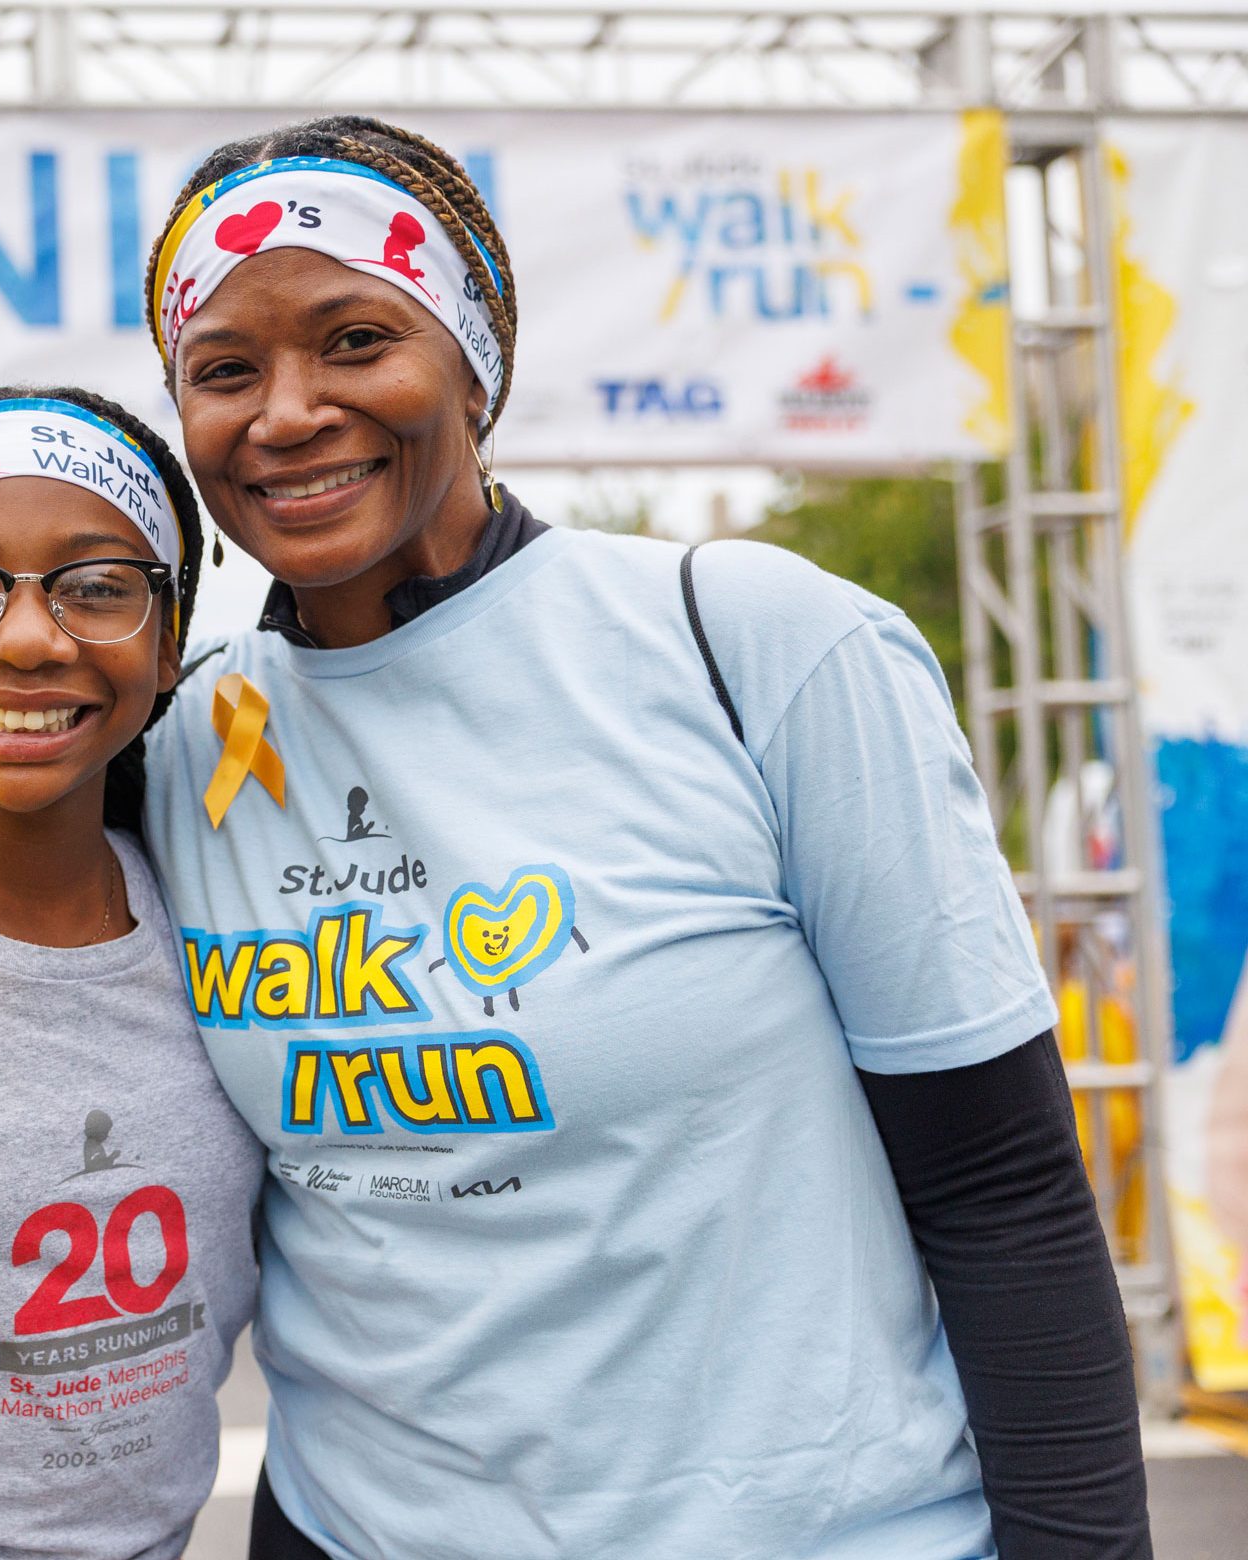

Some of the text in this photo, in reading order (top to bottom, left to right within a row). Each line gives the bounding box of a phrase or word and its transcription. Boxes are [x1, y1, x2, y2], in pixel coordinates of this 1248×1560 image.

[624, 166, 858, 250] walk
[30, 425, 163, 510] St. Jude
[32, 448, 162, 545] Walk/Run
[279, 854, 428, 896] St. Jude
[185, 909, 420, 1020] walk
[422, 1145, 454, 1154] Madison
[369, 1189, 431, 1202] FOUNDATION
[370, 1175, 430, 1195] MARCUM
[11, 1185, 189, 1336] 20
[16, 1315, 179, 1366] YEARS RUNNING
[9, 1349, 188, 1398] St. Jude Memphis
[109, 1368, 190, 1410] Weekend
